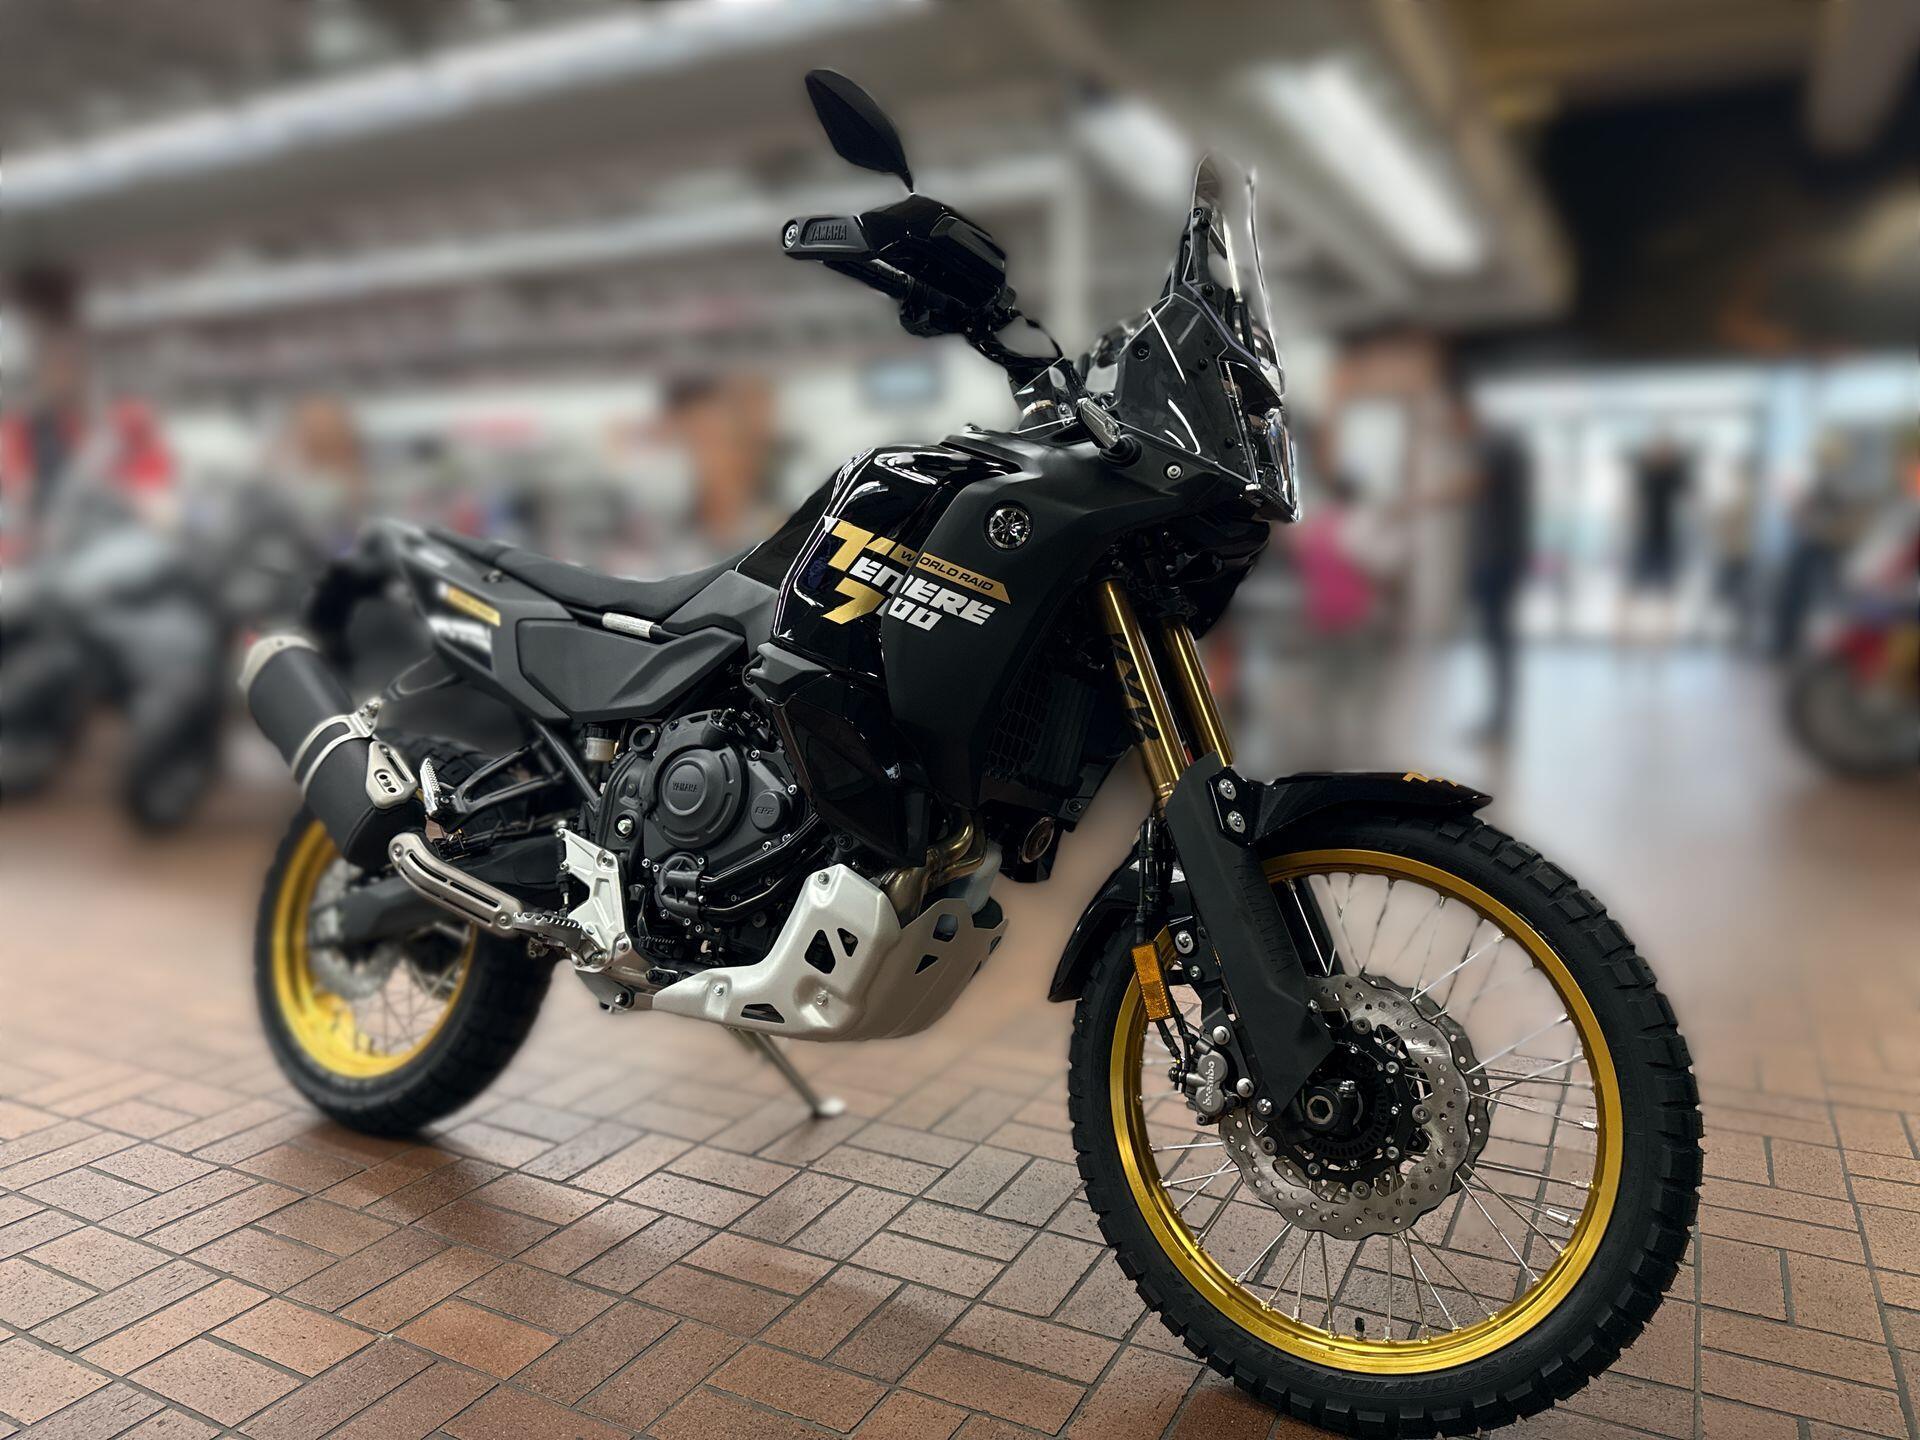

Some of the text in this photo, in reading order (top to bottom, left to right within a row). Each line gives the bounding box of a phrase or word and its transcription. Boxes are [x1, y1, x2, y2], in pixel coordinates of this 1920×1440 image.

[809, 223, 847, 241] YAMAHA
[900, 549, 994, 592] WORLD RAID
[821, 576, 943, 631] 700
[672, 781, 698, 792] YAMAHA
[1202, 1060, 1215, 1106] brembo
